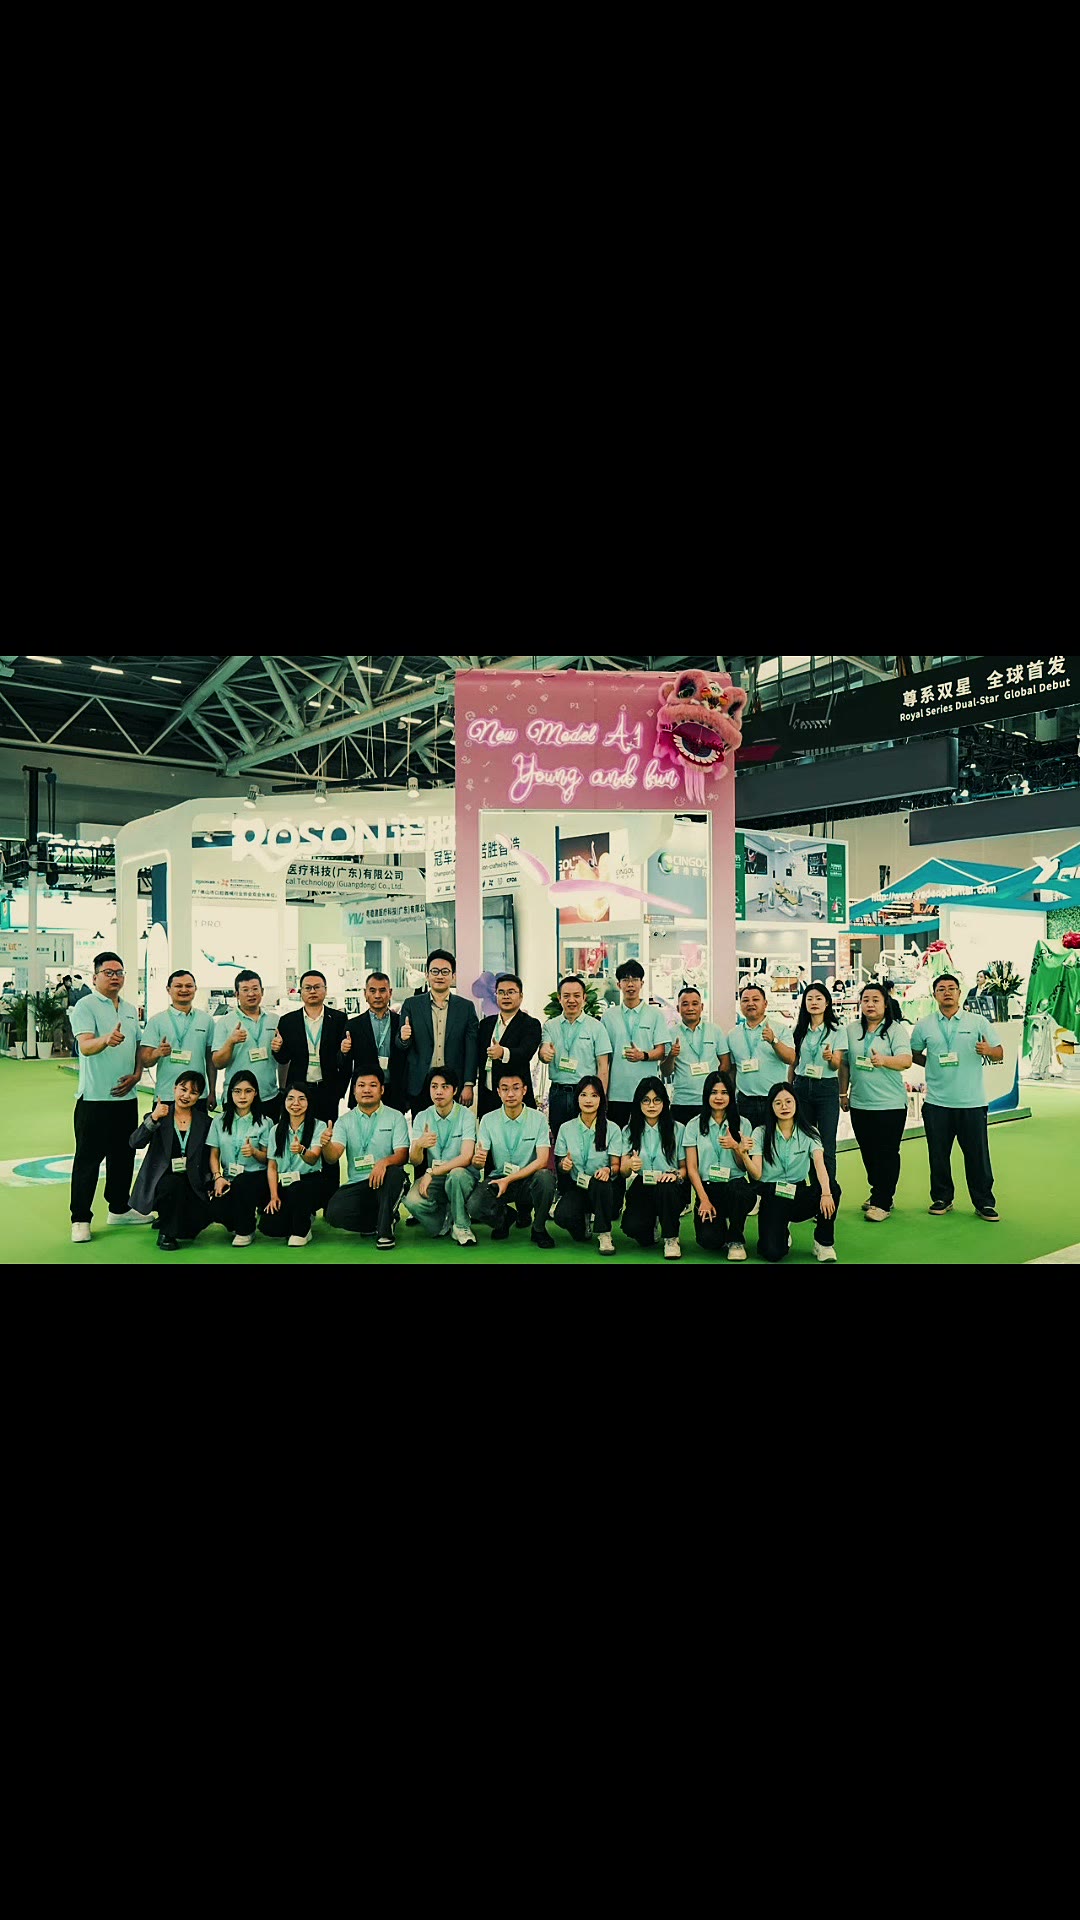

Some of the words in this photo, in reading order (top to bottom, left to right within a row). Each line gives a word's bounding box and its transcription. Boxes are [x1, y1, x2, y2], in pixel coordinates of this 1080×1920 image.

[900, 709, 924, 722] Royal
[926, 704, 953, 717] Series
[955, 694, 1000, 711] Dual-Star
[1004, 684, 1036, 700] Global
[1039, 678, 1071, 693] Debut
[903, 676, 972, 708] 尊系双星
[987, 656, 1067, 690] 全球首发
[468, 719, 517, 745] New
[527, 719, 598, 746] Model
[603, 712, 643, 753] A1
[510, 753, 583, 803] Young
[590, 754, 638, 788] and
[232, 816, 387, 873] ROSON
[434, 849, 456, 867] 冠军
[287, 864, 404, 880] 医疗科技(广东)有限公司
[297, 878, 335, 888] Technology
